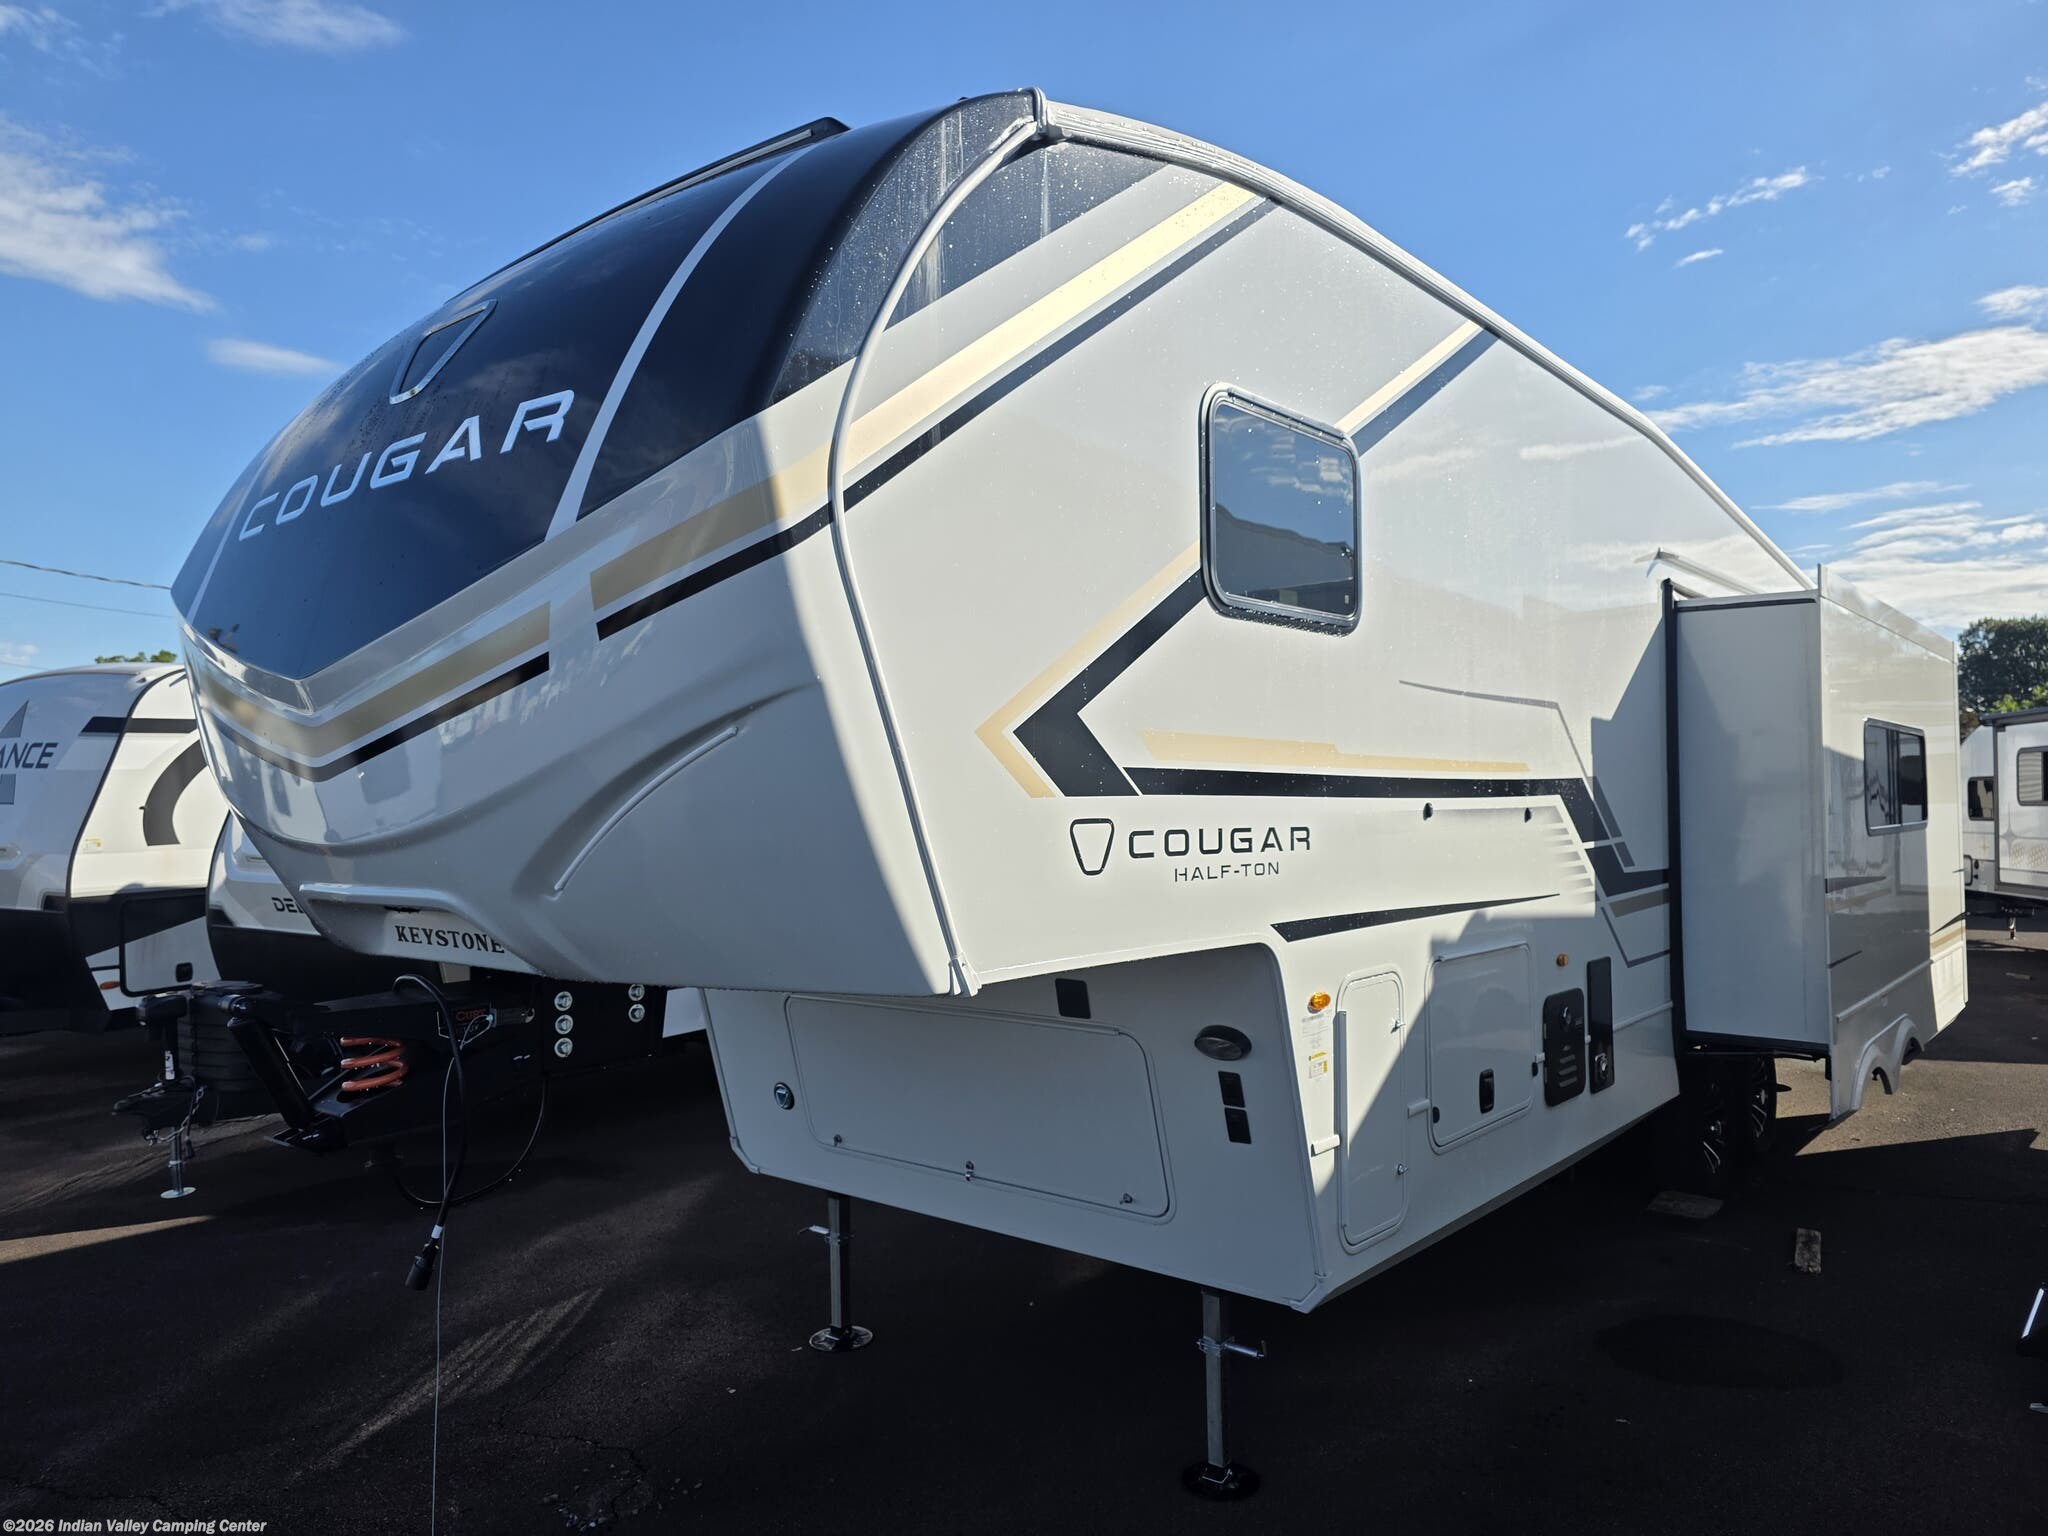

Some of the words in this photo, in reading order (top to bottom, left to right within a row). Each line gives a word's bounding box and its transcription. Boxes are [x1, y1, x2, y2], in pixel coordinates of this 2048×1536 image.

[239, 389, 575, 541] COUGAR
[1128, 826, 1311, 859] COUGAR
[1174, 861, 1280, 882] HALF-TON
[395, 925, 505, 954] KEYSTONE
